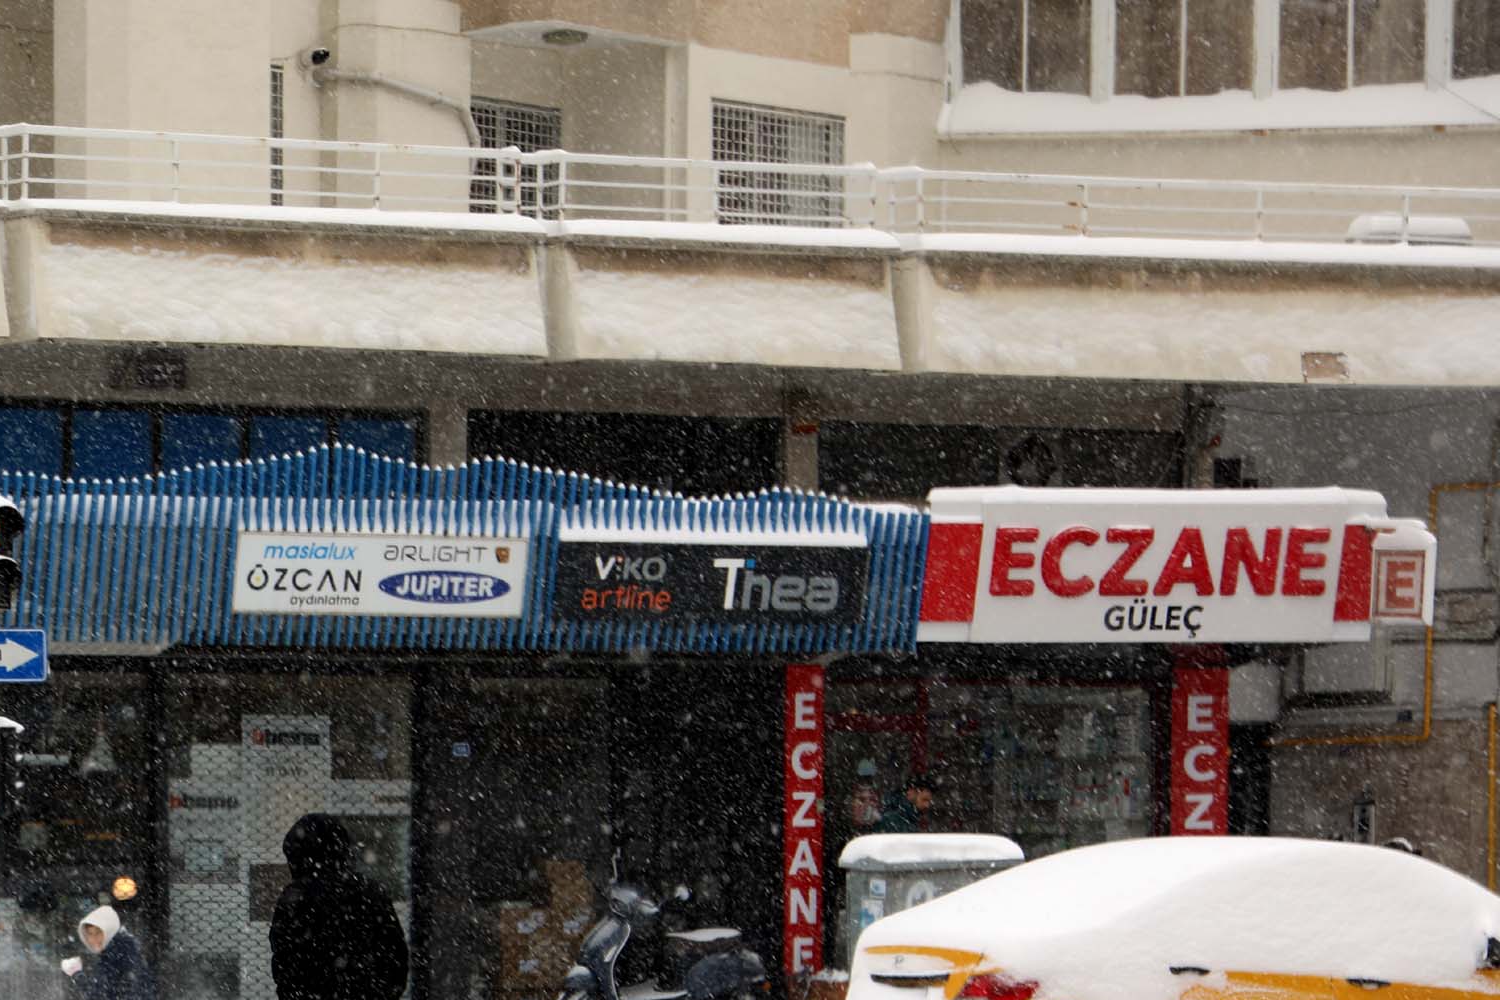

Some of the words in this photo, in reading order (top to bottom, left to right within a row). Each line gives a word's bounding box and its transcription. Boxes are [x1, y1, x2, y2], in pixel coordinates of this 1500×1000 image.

[263, 542, 358, 561] masialux
[989, 526, 1331, 598] ECZANE
[246, 564, 363, 592] ÖZCAN
[396, 575, 495, 597] JUPITER
[580, 584, 672, 611] artline
[713, 557, 840, 611] Thea
[1385, 561, 1415, 609] E
[1103, 599, 1205, 639] GÜLEÇ
[788, 691, 820, 973] ECZANE
